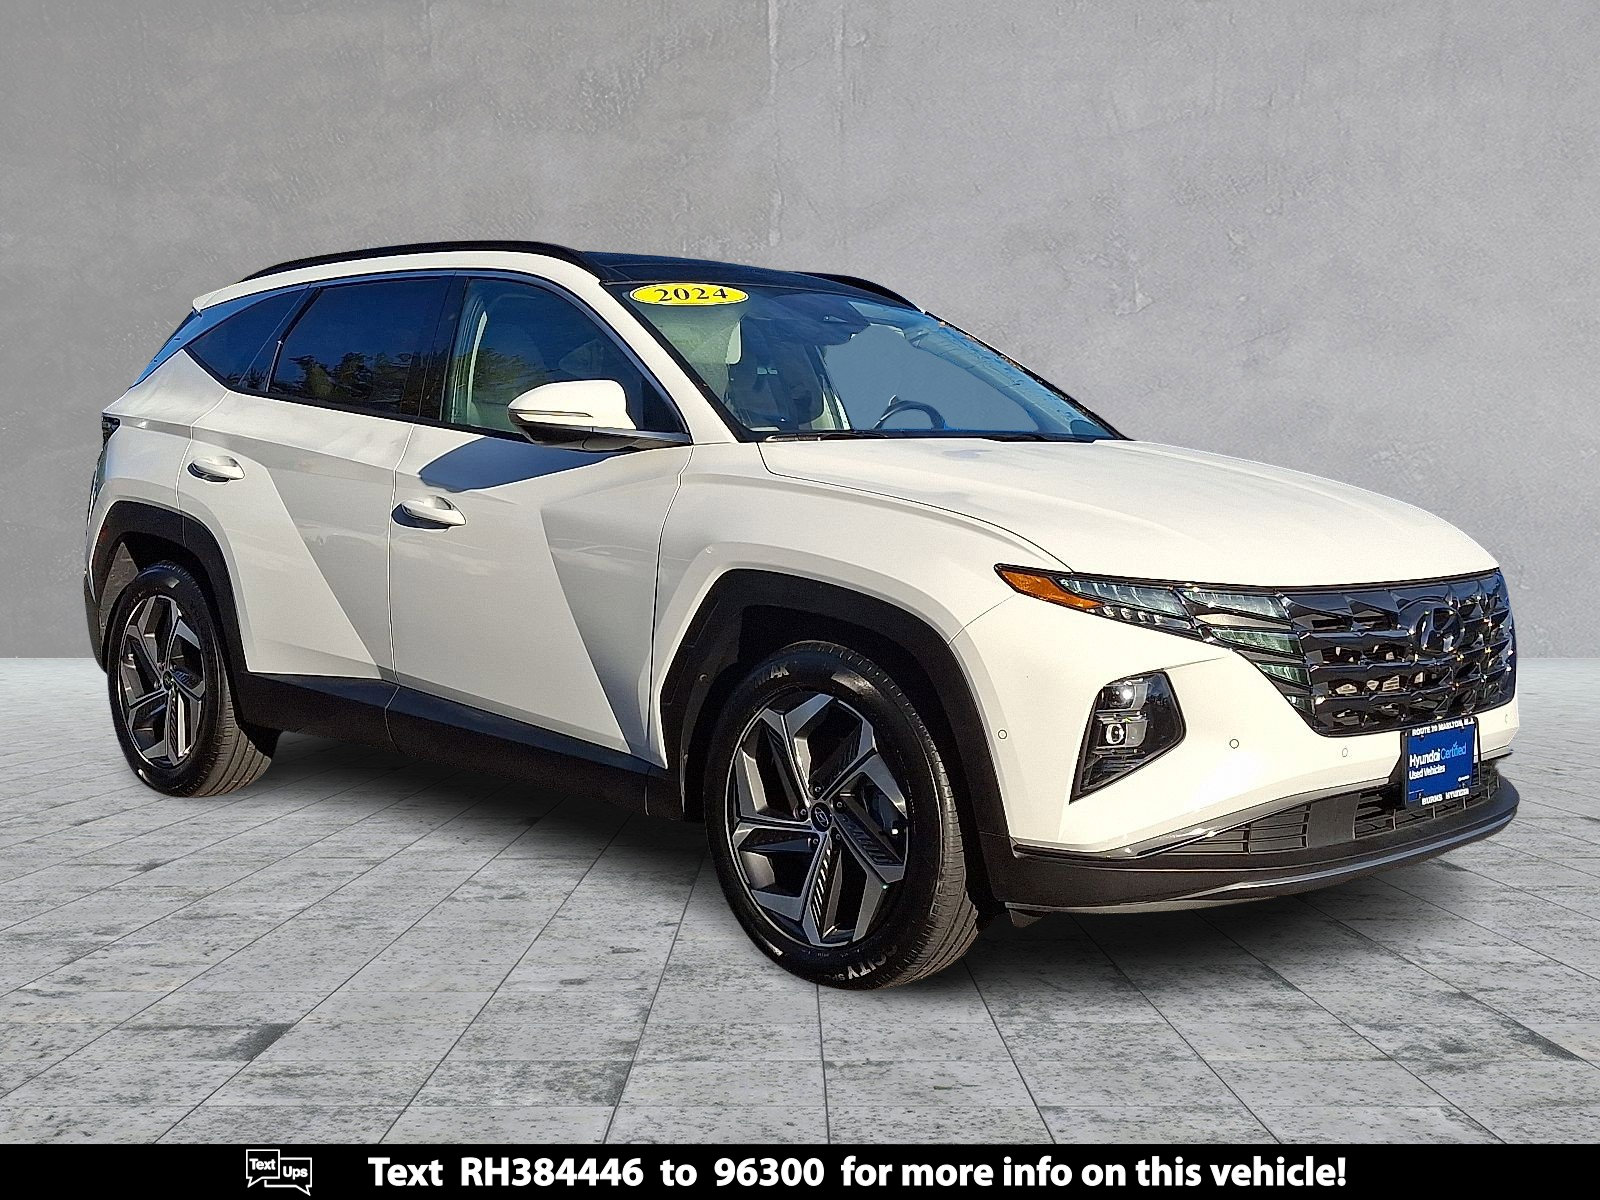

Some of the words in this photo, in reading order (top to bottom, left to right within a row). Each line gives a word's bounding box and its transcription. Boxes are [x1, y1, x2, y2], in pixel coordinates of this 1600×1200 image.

[654, 287, 729, 302] 2024
[1411, 725, 1431, 737] ROUTE
[1408, 768, 1424, 780] Used
[1423, 764, 1446, 777] Vehicles
